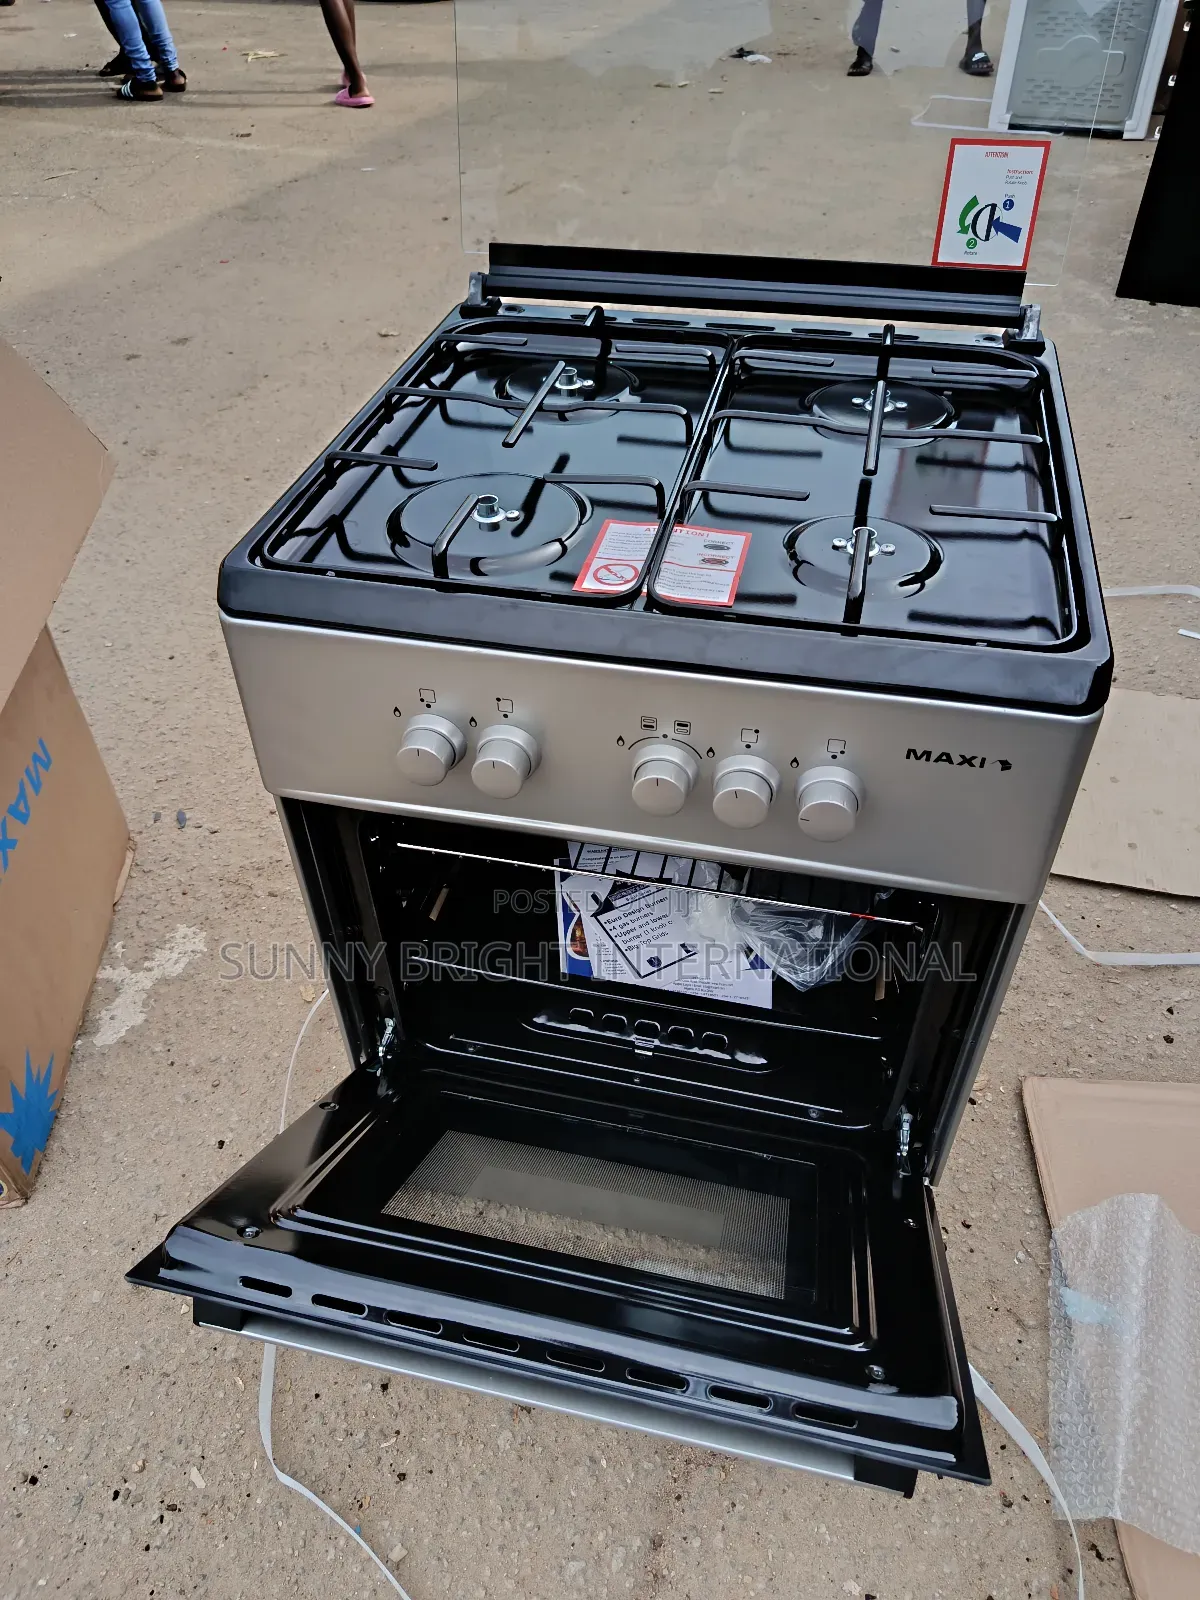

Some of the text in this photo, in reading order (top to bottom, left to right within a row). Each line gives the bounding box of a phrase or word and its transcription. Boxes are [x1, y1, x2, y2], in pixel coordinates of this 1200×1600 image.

[703, 538, 736, 546] CORRECT
[905, 748, 987, 769] MAXI
[606, 915, 623, 925] Euro
[622, 906, 645, 919] Design
[616, 926, 637, 938] Upper
[638, 920, 650, 929] and
[650, 913, 669, 924] lower
[618, 921, 630, 930] gas
[629, 911, 654, 924] burners
[621, 933, 643, 945] burner
[650, 922, 667, 933] knob
